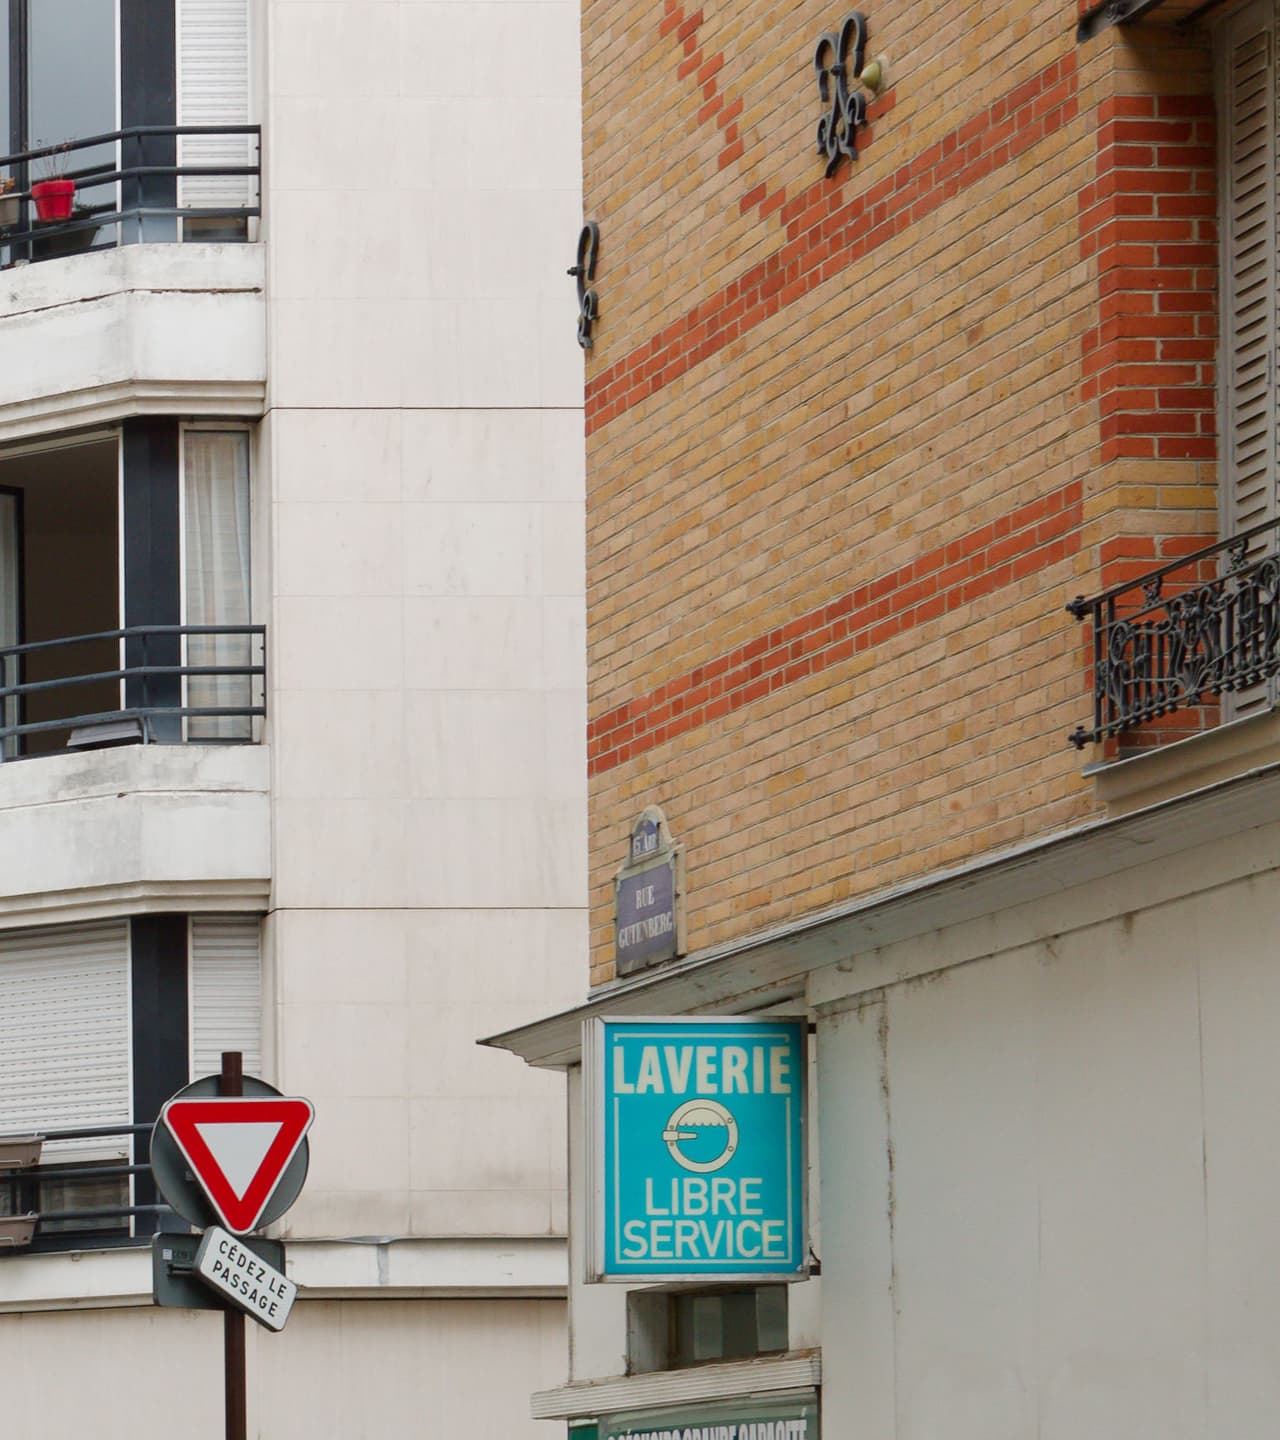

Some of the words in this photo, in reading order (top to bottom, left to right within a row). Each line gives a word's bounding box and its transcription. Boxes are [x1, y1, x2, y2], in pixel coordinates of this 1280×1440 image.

[635, 885, 654, 910] RUE
[618, 911, 672, 949] GUTENBERG
[613, 1046, 791, 1094] LAVERIE
[645, 1177, 763, 1216] LIBRE
[622, 1219, 785, 1258] SERVICE
[212, 1260, 279, 1317] PASSAGE
[218, 1240, 267, 1284] CÉDEZ
[268, 1277, 287, 1300] LE
